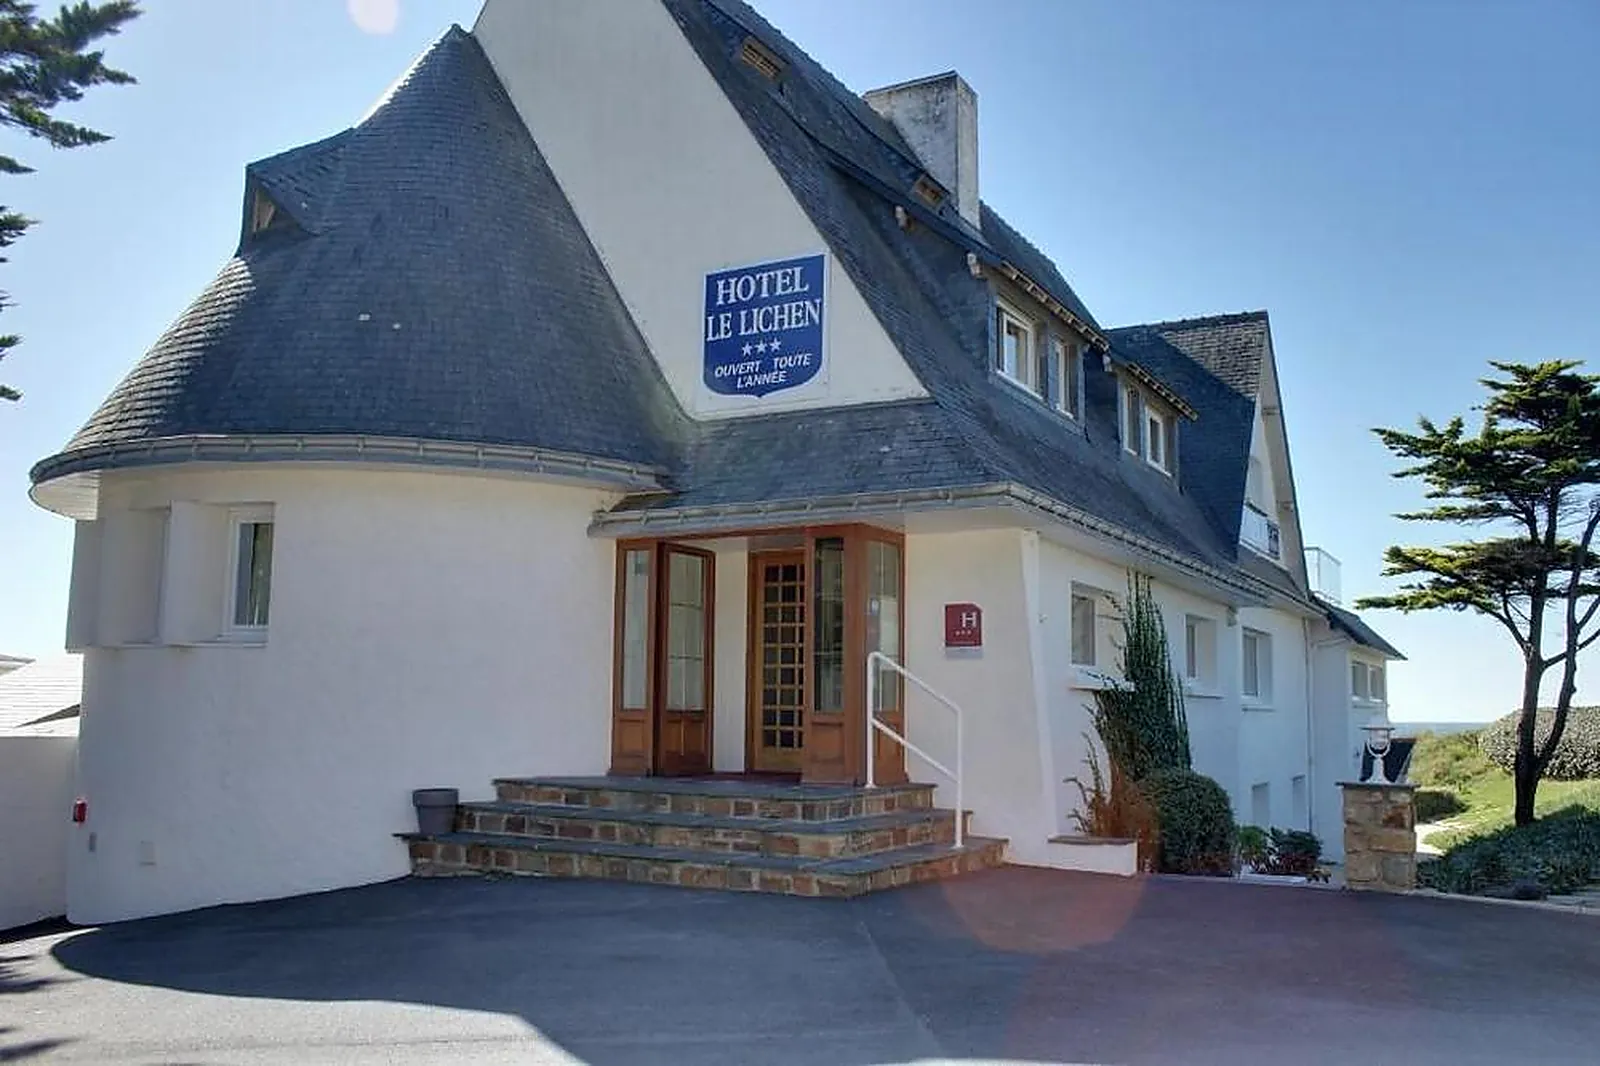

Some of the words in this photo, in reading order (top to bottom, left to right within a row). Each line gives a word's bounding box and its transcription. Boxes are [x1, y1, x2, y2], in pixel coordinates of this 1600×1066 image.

[716, 266, 809, 305] HOTEL
[706, 313, 732, 341] LE
[738, 298, 822, 335] LICHEN
[715, 360, 762, 378] OUVERT
[773, 353, 812, 369] TOUTE
[962, 612, 977, 628] H
